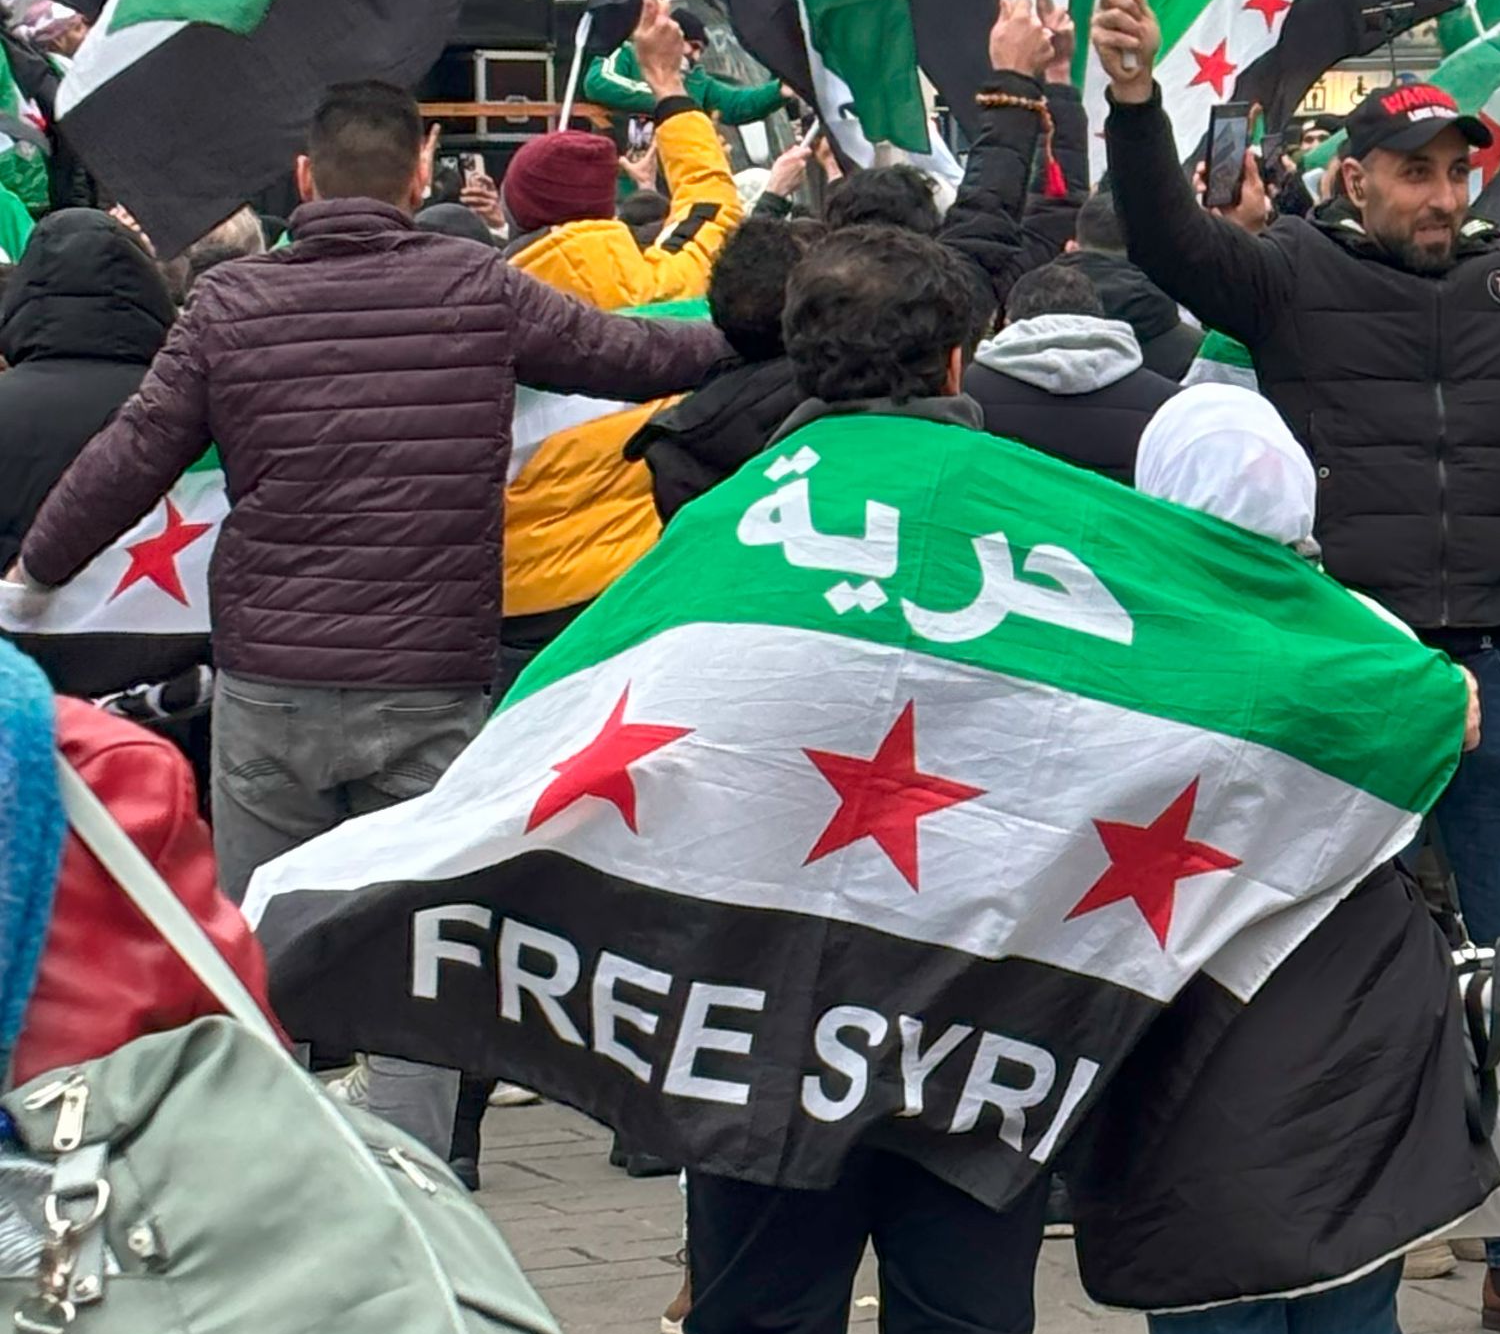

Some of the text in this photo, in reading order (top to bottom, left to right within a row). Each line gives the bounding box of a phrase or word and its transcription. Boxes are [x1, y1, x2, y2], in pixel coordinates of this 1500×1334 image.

[736, 445, 1134, 644] حرية
[410, 903, 1100, 1165] FREE SYRI
